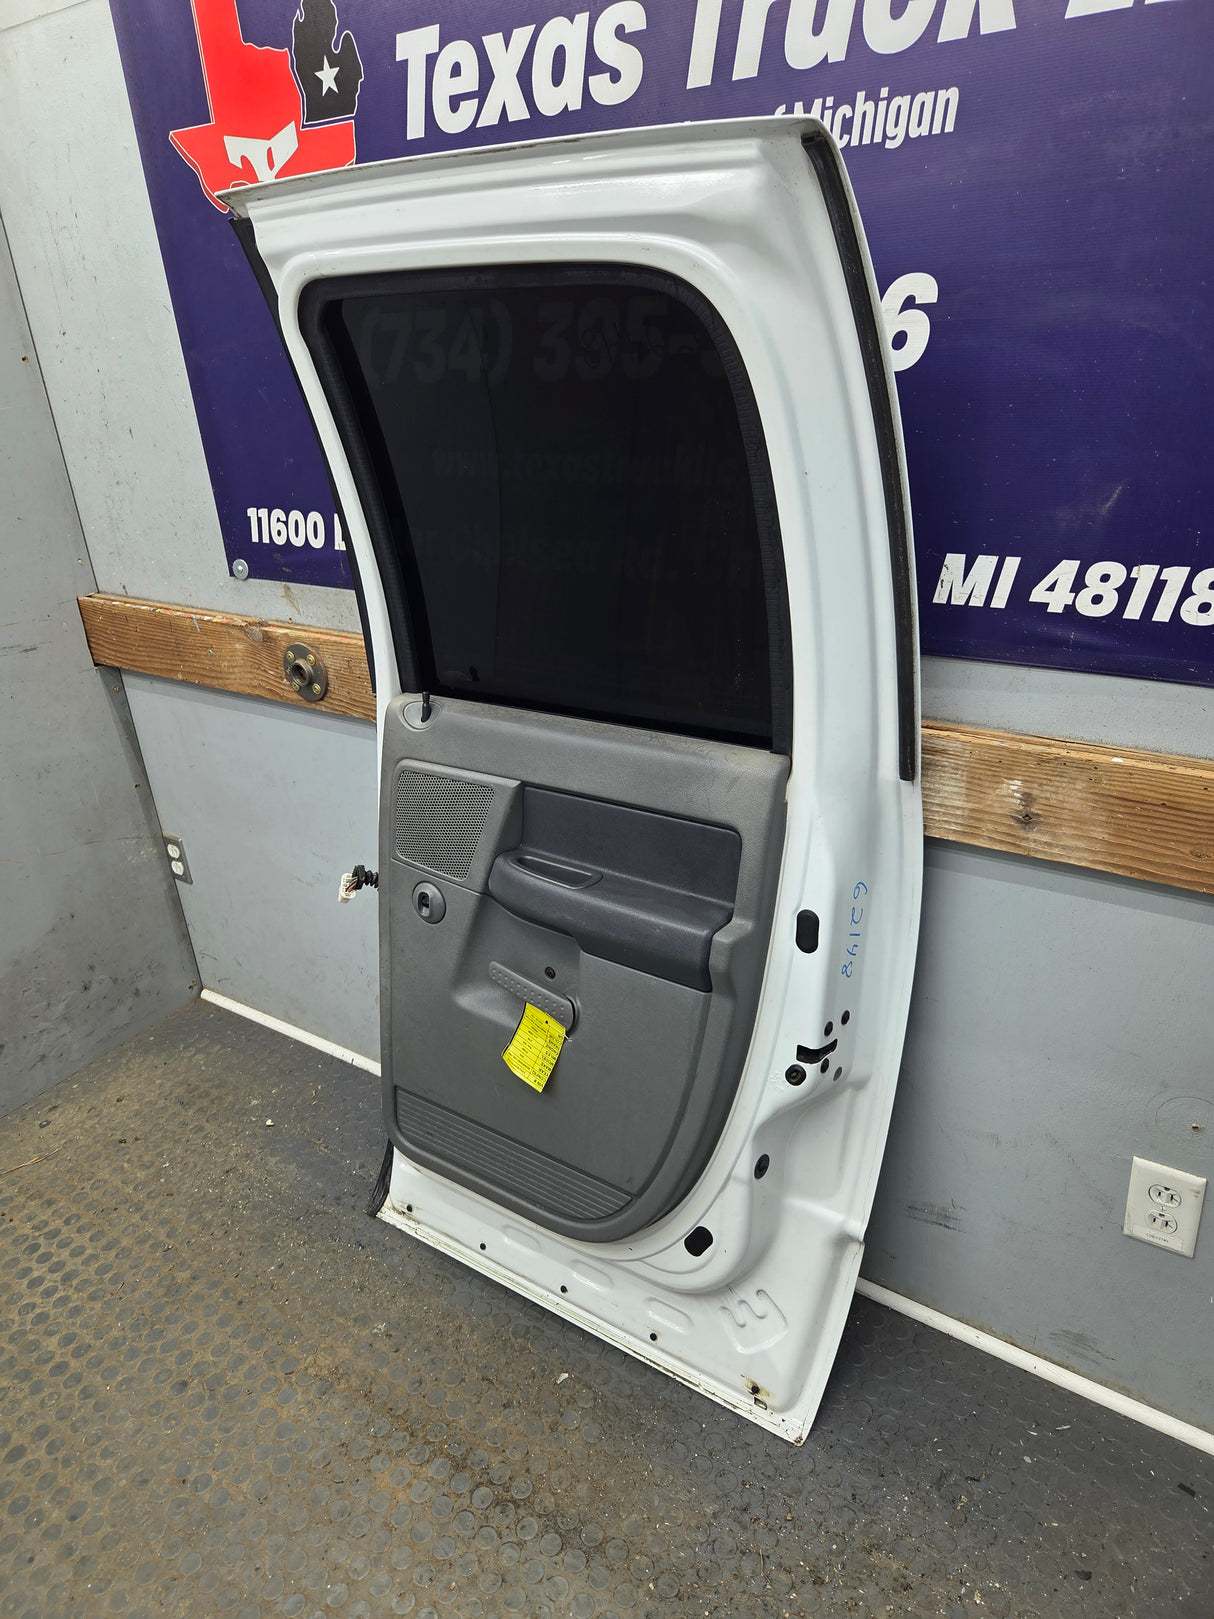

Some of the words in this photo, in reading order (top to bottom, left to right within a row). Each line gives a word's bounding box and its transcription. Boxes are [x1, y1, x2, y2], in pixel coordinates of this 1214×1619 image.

[396, 1, 646, 140] Texas
[247, 507, 325, 549] 11600
[932, 553, 1022, 609] MI
[1029, 559, 1214, 627] 48118
